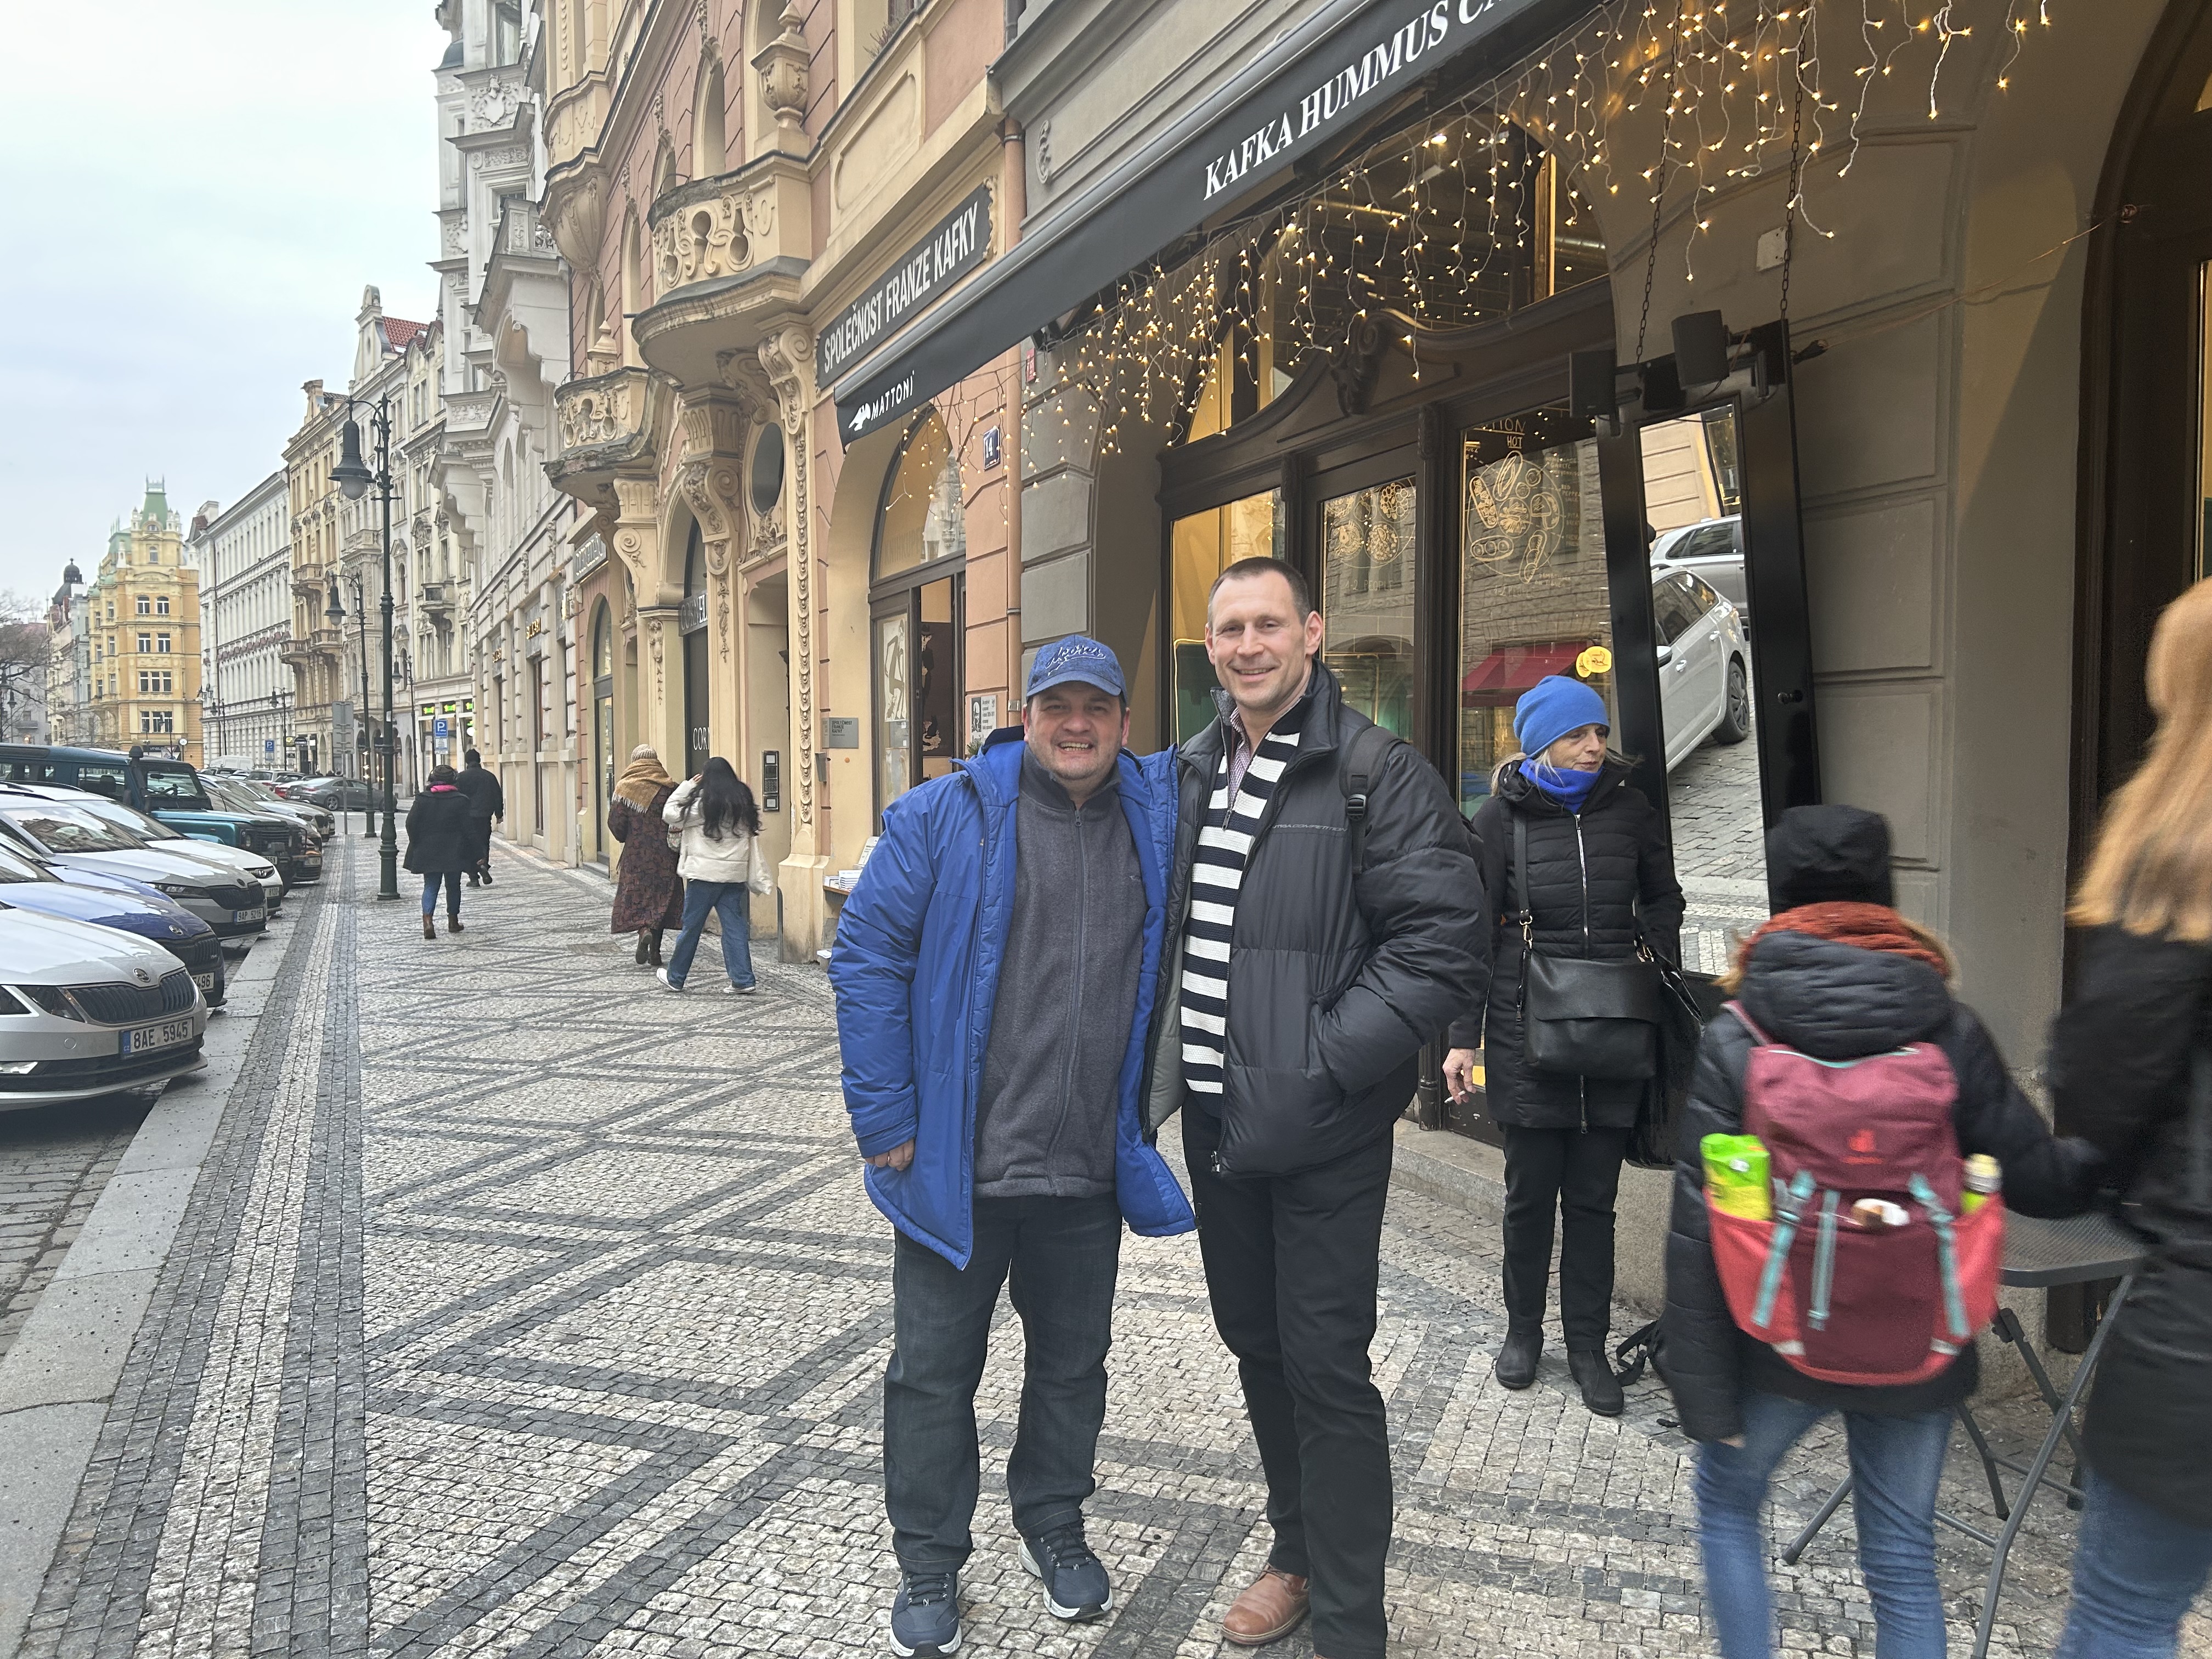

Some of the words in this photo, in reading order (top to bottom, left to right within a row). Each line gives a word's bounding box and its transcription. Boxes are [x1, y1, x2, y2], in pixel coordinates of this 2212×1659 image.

[1203, 112, 1294, 201] KAFKA
[1297, 1, 1448, 139] HUMMUS
[825, 290, 883, 374] SPOLEČNOST
[886, 246, 930, 323] FRANZE
[934, 201, 978, 283] KAFKY
[870, 375, 913, 421] MATTONI
[985, 437, 994, 459] 14
[1506, 435, 1522, 447] HOT
[1364, 580, 1394, 591] PEOPLE
[238, 911, 248, 921] 9AP
[133, 1028, 155, 1049] 8AE
[163, 1021, 188, 1042] 5945
